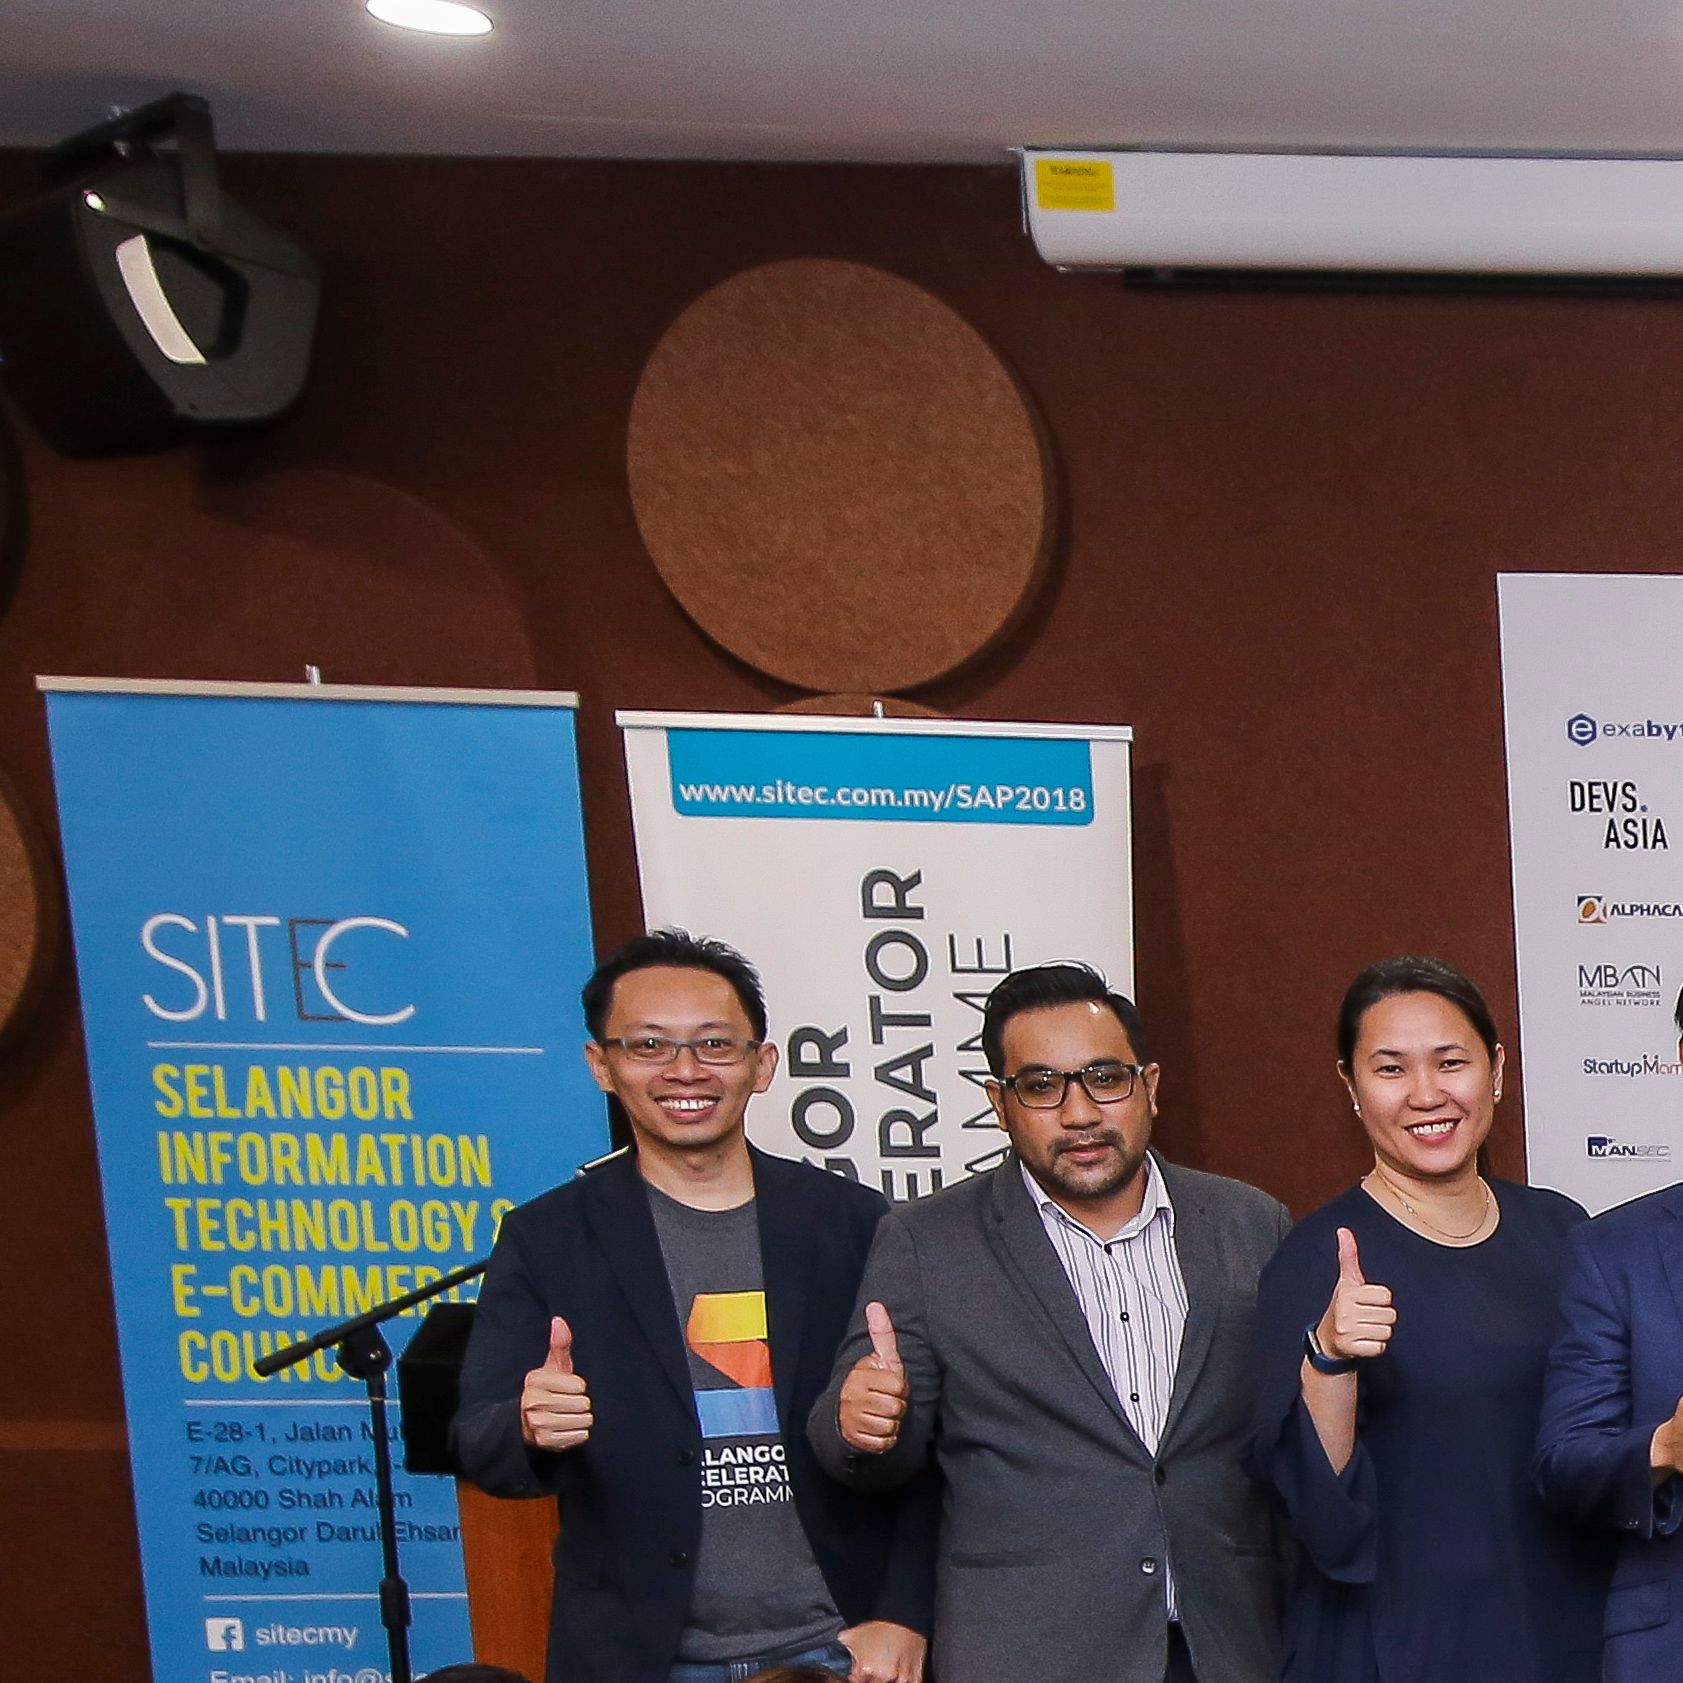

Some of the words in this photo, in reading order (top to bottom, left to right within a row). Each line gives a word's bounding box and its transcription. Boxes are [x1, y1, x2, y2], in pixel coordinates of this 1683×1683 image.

[680, 779, 1088, 813] www.sitec.com.my/SAP2018
[1604, 820, 1669, 849] ASIA
[141, 913, 416, 1026] SITEC
[152, 1062, 411, 1121] SELANGOR
[157, 1131, 493, 1188] INFORMATION
[164, 1197, 480, 1253] TECHNOLOGY
[285, 1422, 352, 1442] Jalan
[193, 1489, 269, 1509] 40000
[278, 1489, 345, 1509] Shah
[351, 1490, 413, 1509] Alm
[196, 1523, 308, 1547] Selangor
[316, 1521, 382, 1543] Darul
[200, 1557, 310, 1579] Malaysia
[255, 1623, 358, 1648] sitecmy
